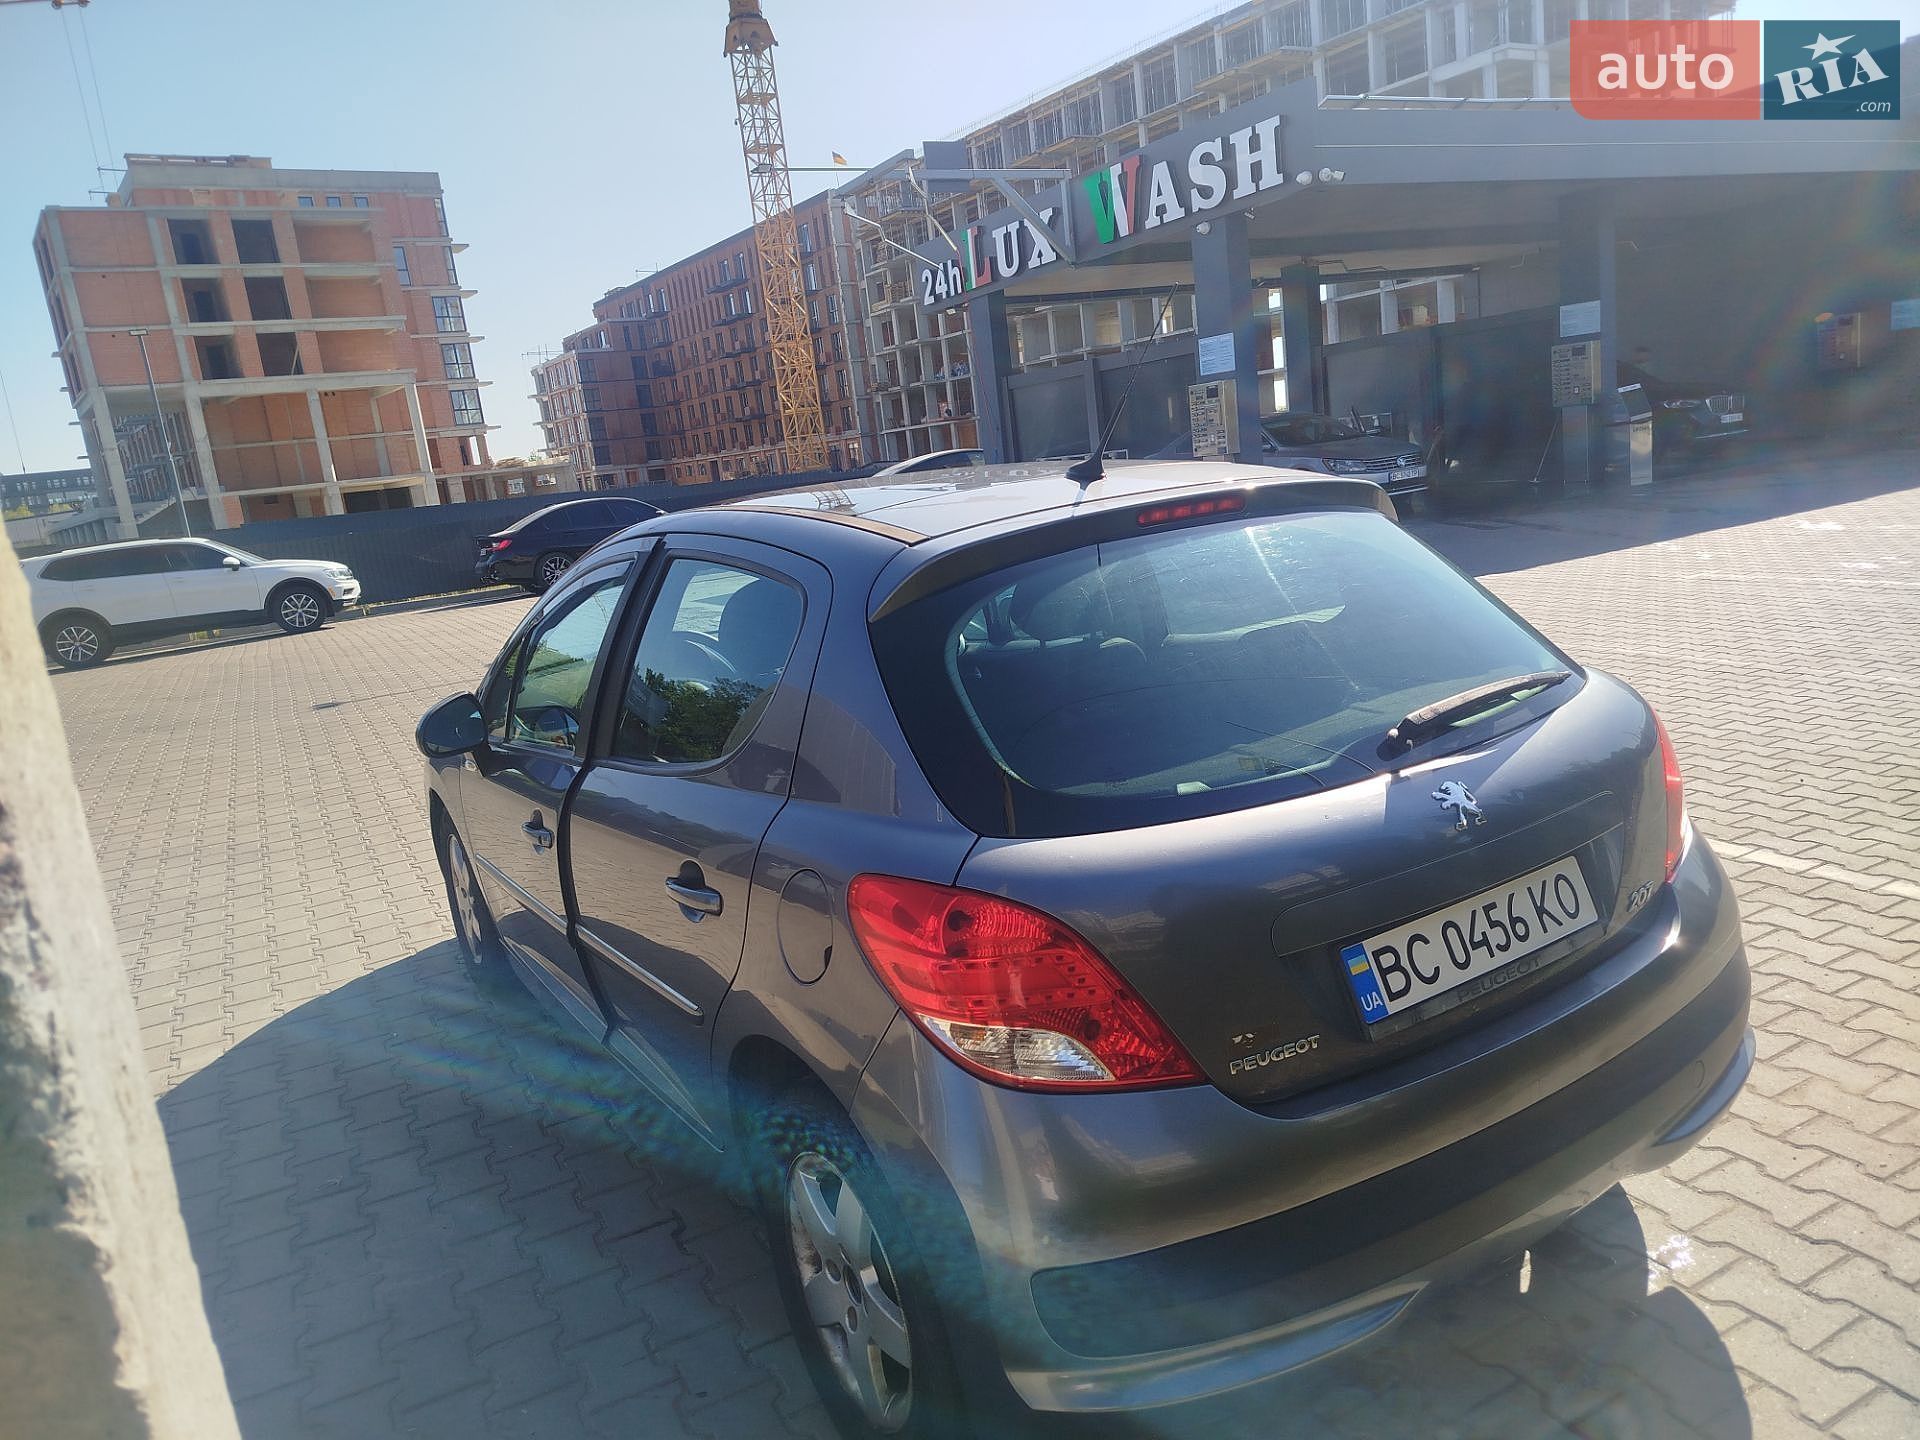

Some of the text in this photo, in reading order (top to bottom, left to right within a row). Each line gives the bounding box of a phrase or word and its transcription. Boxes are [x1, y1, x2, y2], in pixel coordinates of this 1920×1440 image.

[921, 114, 1284, 306] 24h LUX WASH
[1371, 872, 1580, 1002] BC 0456 KO
[1360, 991, 1384, 1012] UA
[1229, 1034, 1320, 1075] PEUGEOT
